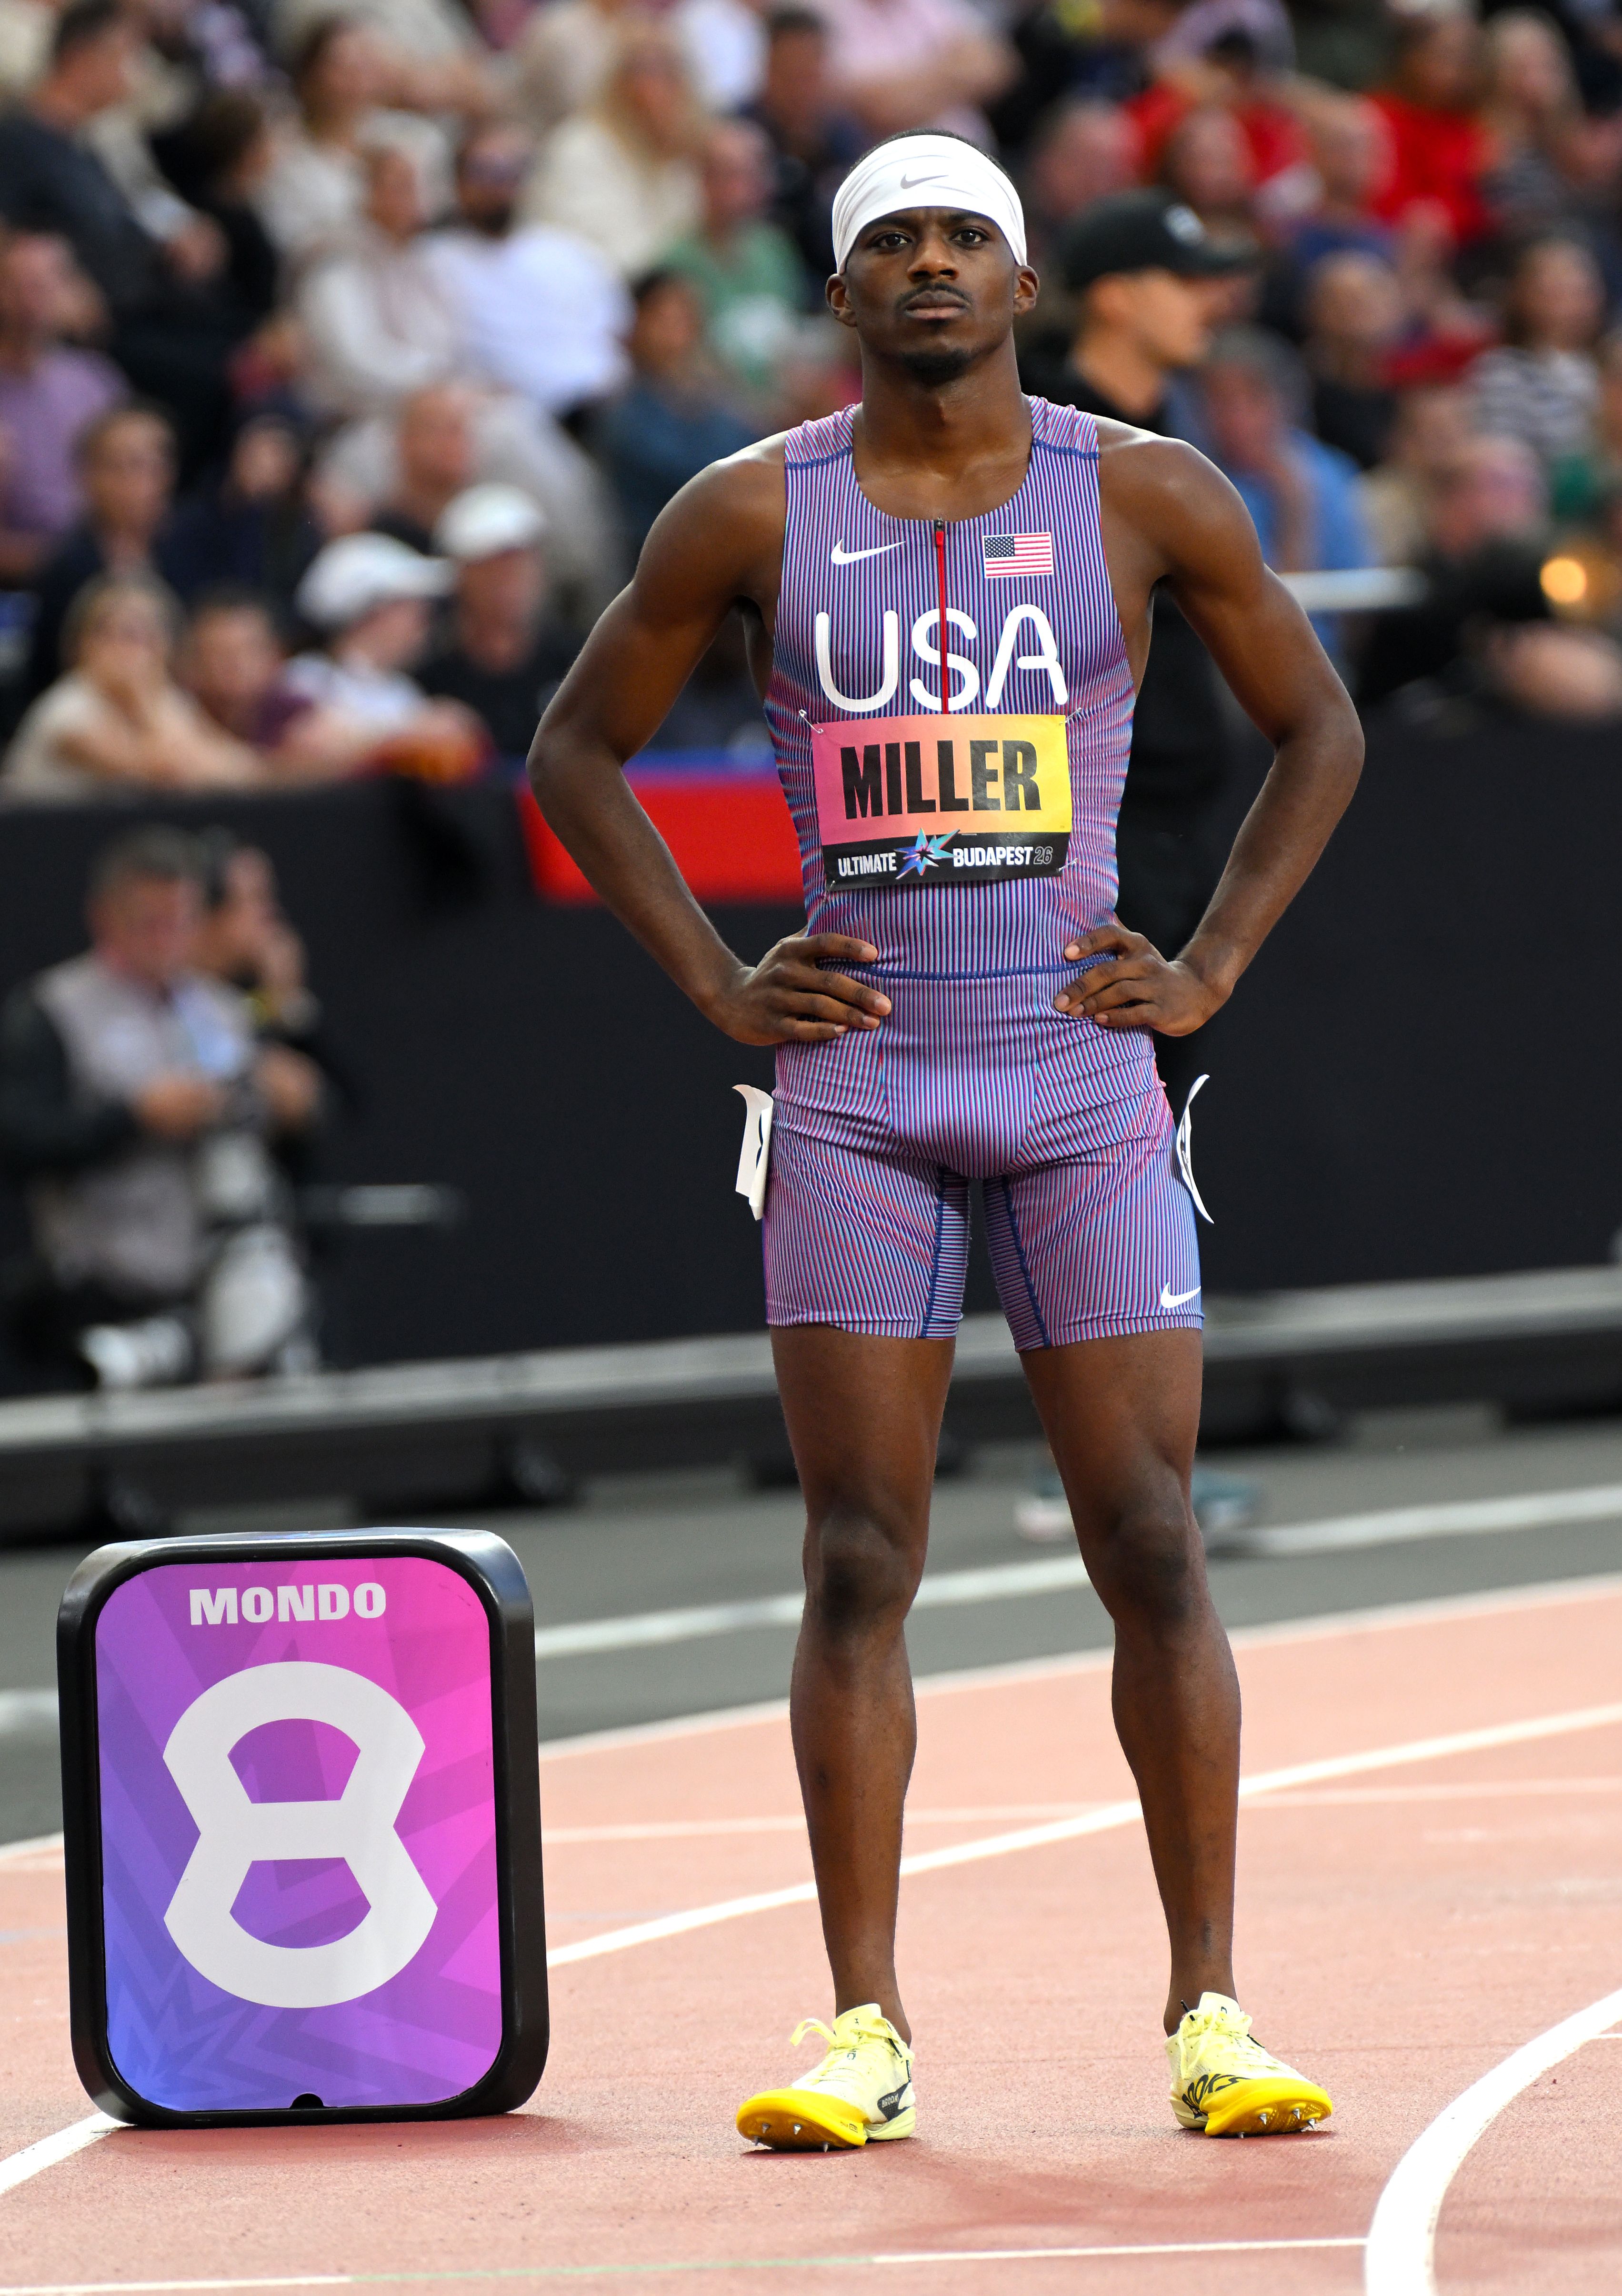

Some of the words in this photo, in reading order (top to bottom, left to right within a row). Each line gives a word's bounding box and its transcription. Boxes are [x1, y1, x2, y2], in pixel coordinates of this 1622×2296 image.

[815, 604, 1068, 712] USA
[841, 740, 1041, 820] MILLER
[838, 852, 897, 876] ULTIMATE
[190, 1583, 386, 1625] MONDO
[162, 1661, 438, 2008] 8
